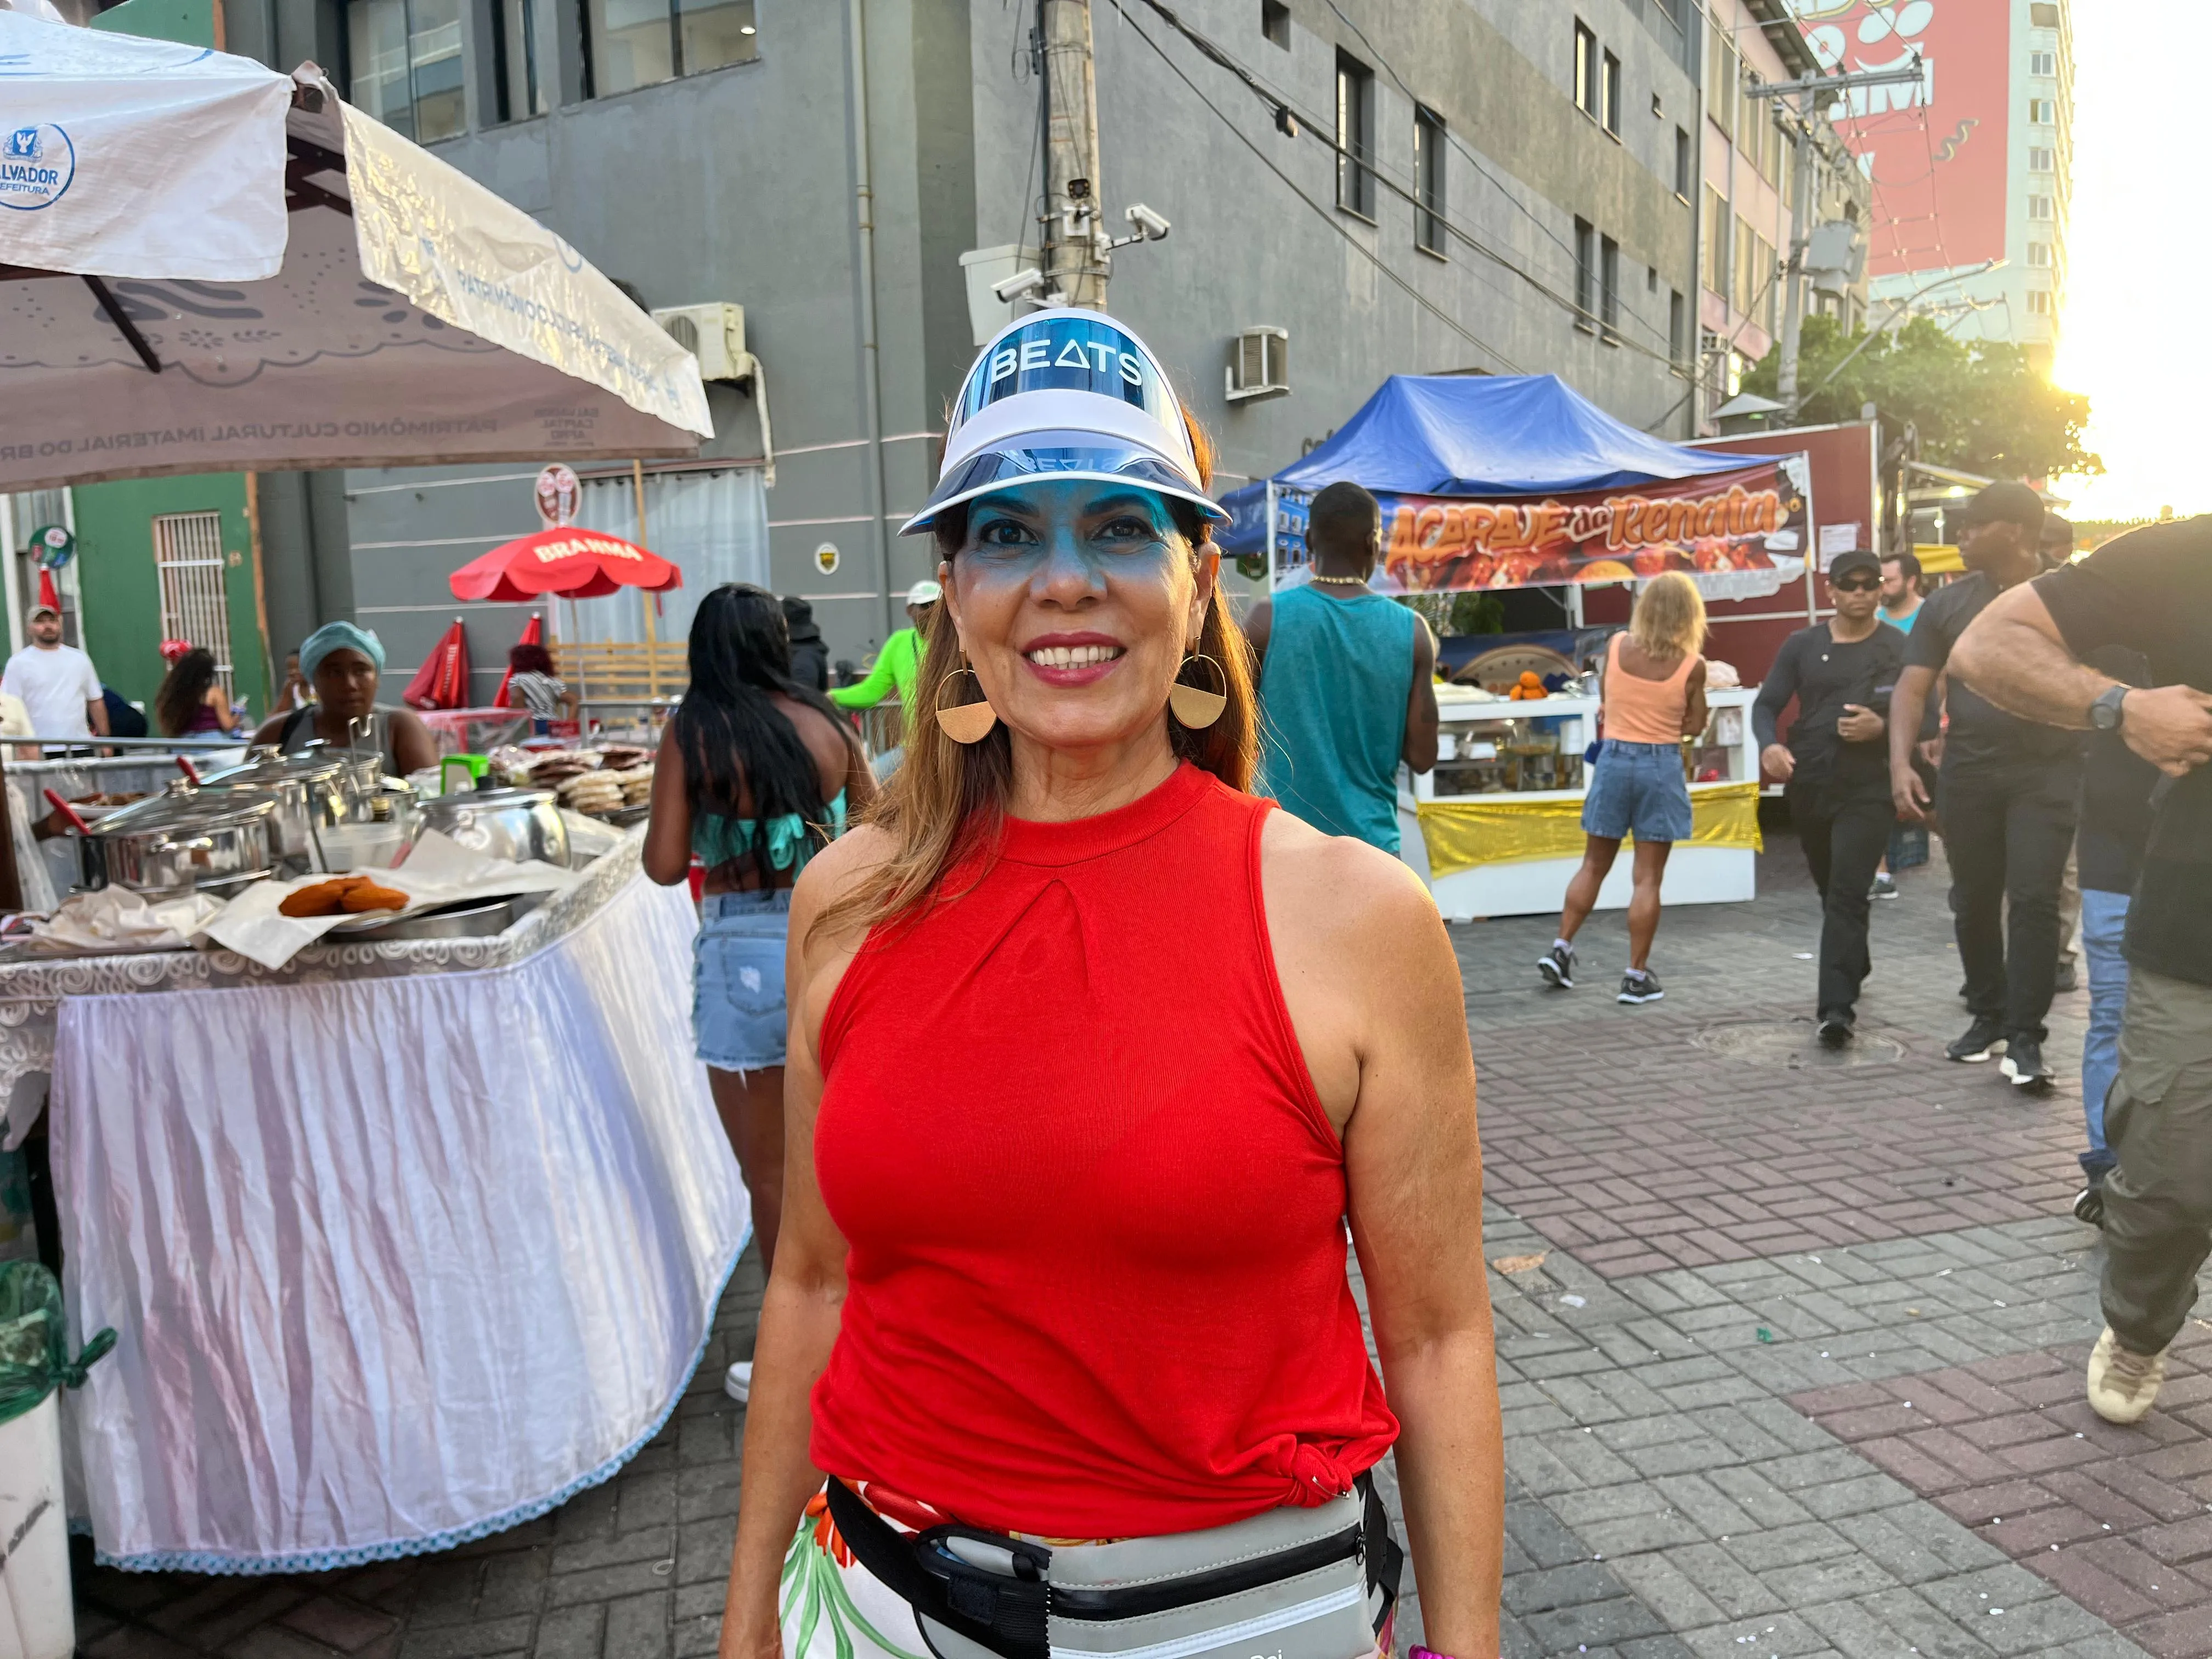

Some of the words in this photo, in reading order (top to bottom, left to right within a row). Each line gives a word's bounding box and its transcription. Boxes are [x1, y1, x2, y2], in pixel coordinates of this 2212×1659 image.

[0, 164, 58, 185] LVADOR
[991, 338, 1143, 386] BEATS
[1605, 484, 1780, 550] Renata
[534, 537, 644, 563] BRAHMA
